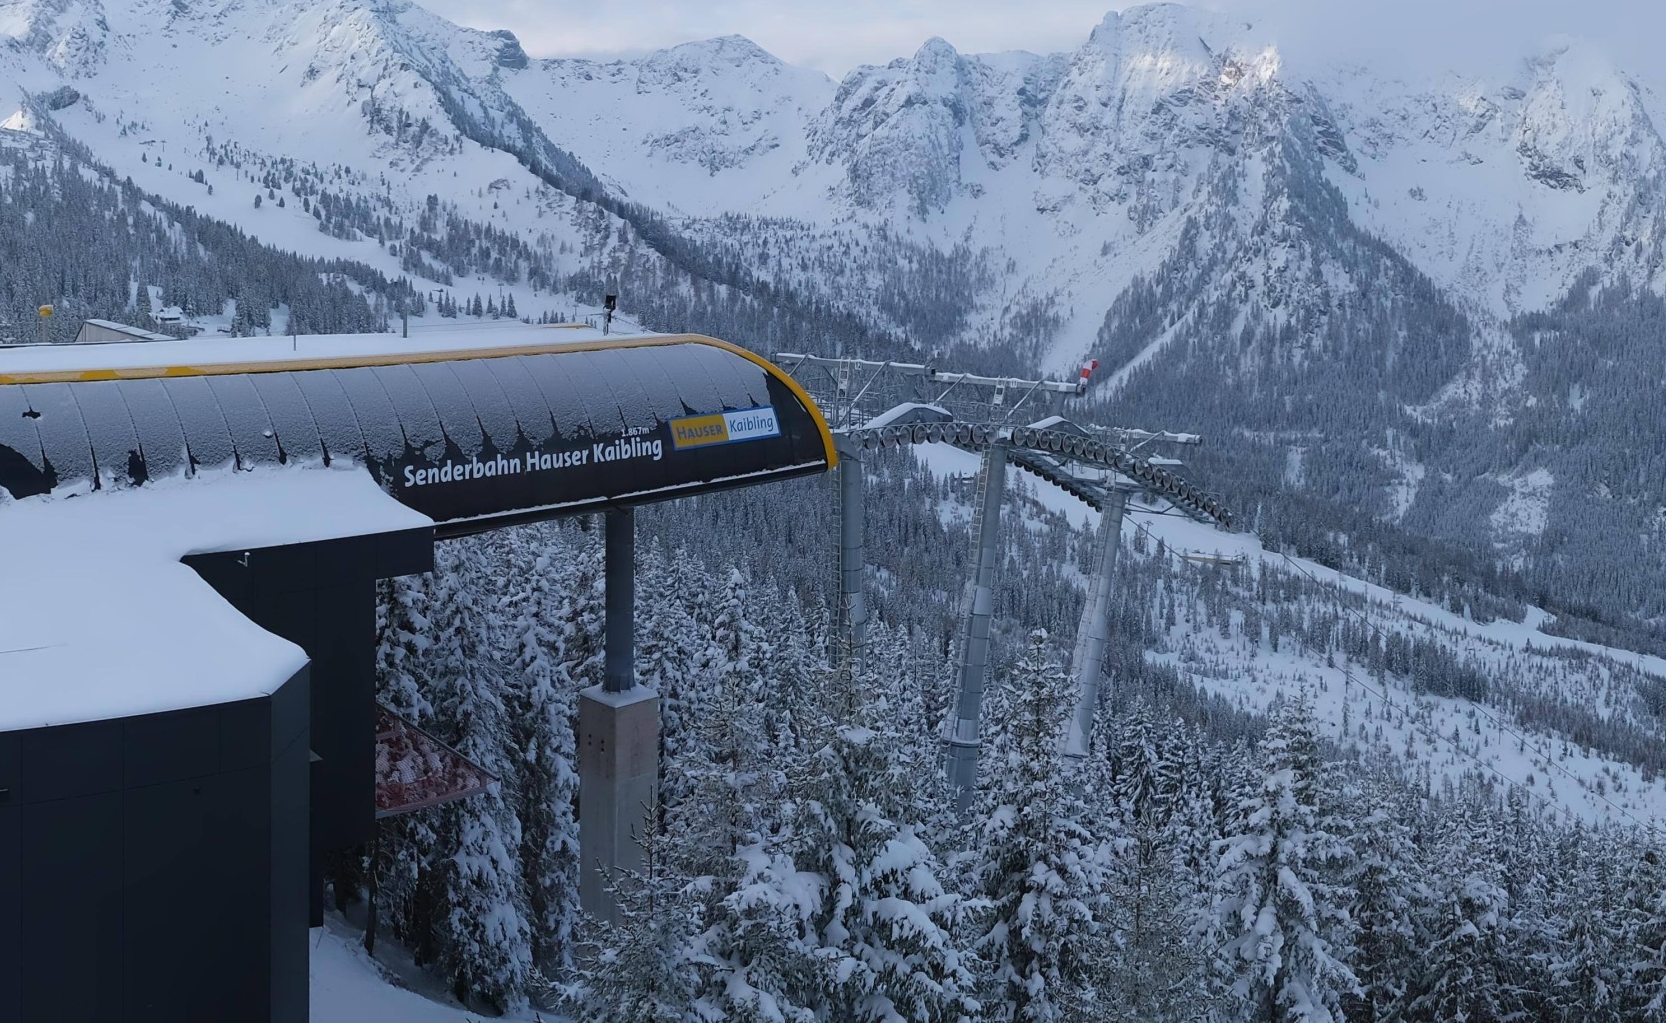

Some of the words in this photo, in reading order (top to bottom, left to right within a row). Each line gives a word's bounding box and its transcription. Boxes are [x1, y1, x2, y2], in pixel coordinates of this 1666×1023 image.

[676, 425, 724, 440] HAUSER
[729, 416, 774, 432] Kaibling
[404, 453, 521, 487] Senderbahn
[526, 447, 588, 472] Hauser
[593, 438, 662, 463] Kaibling
